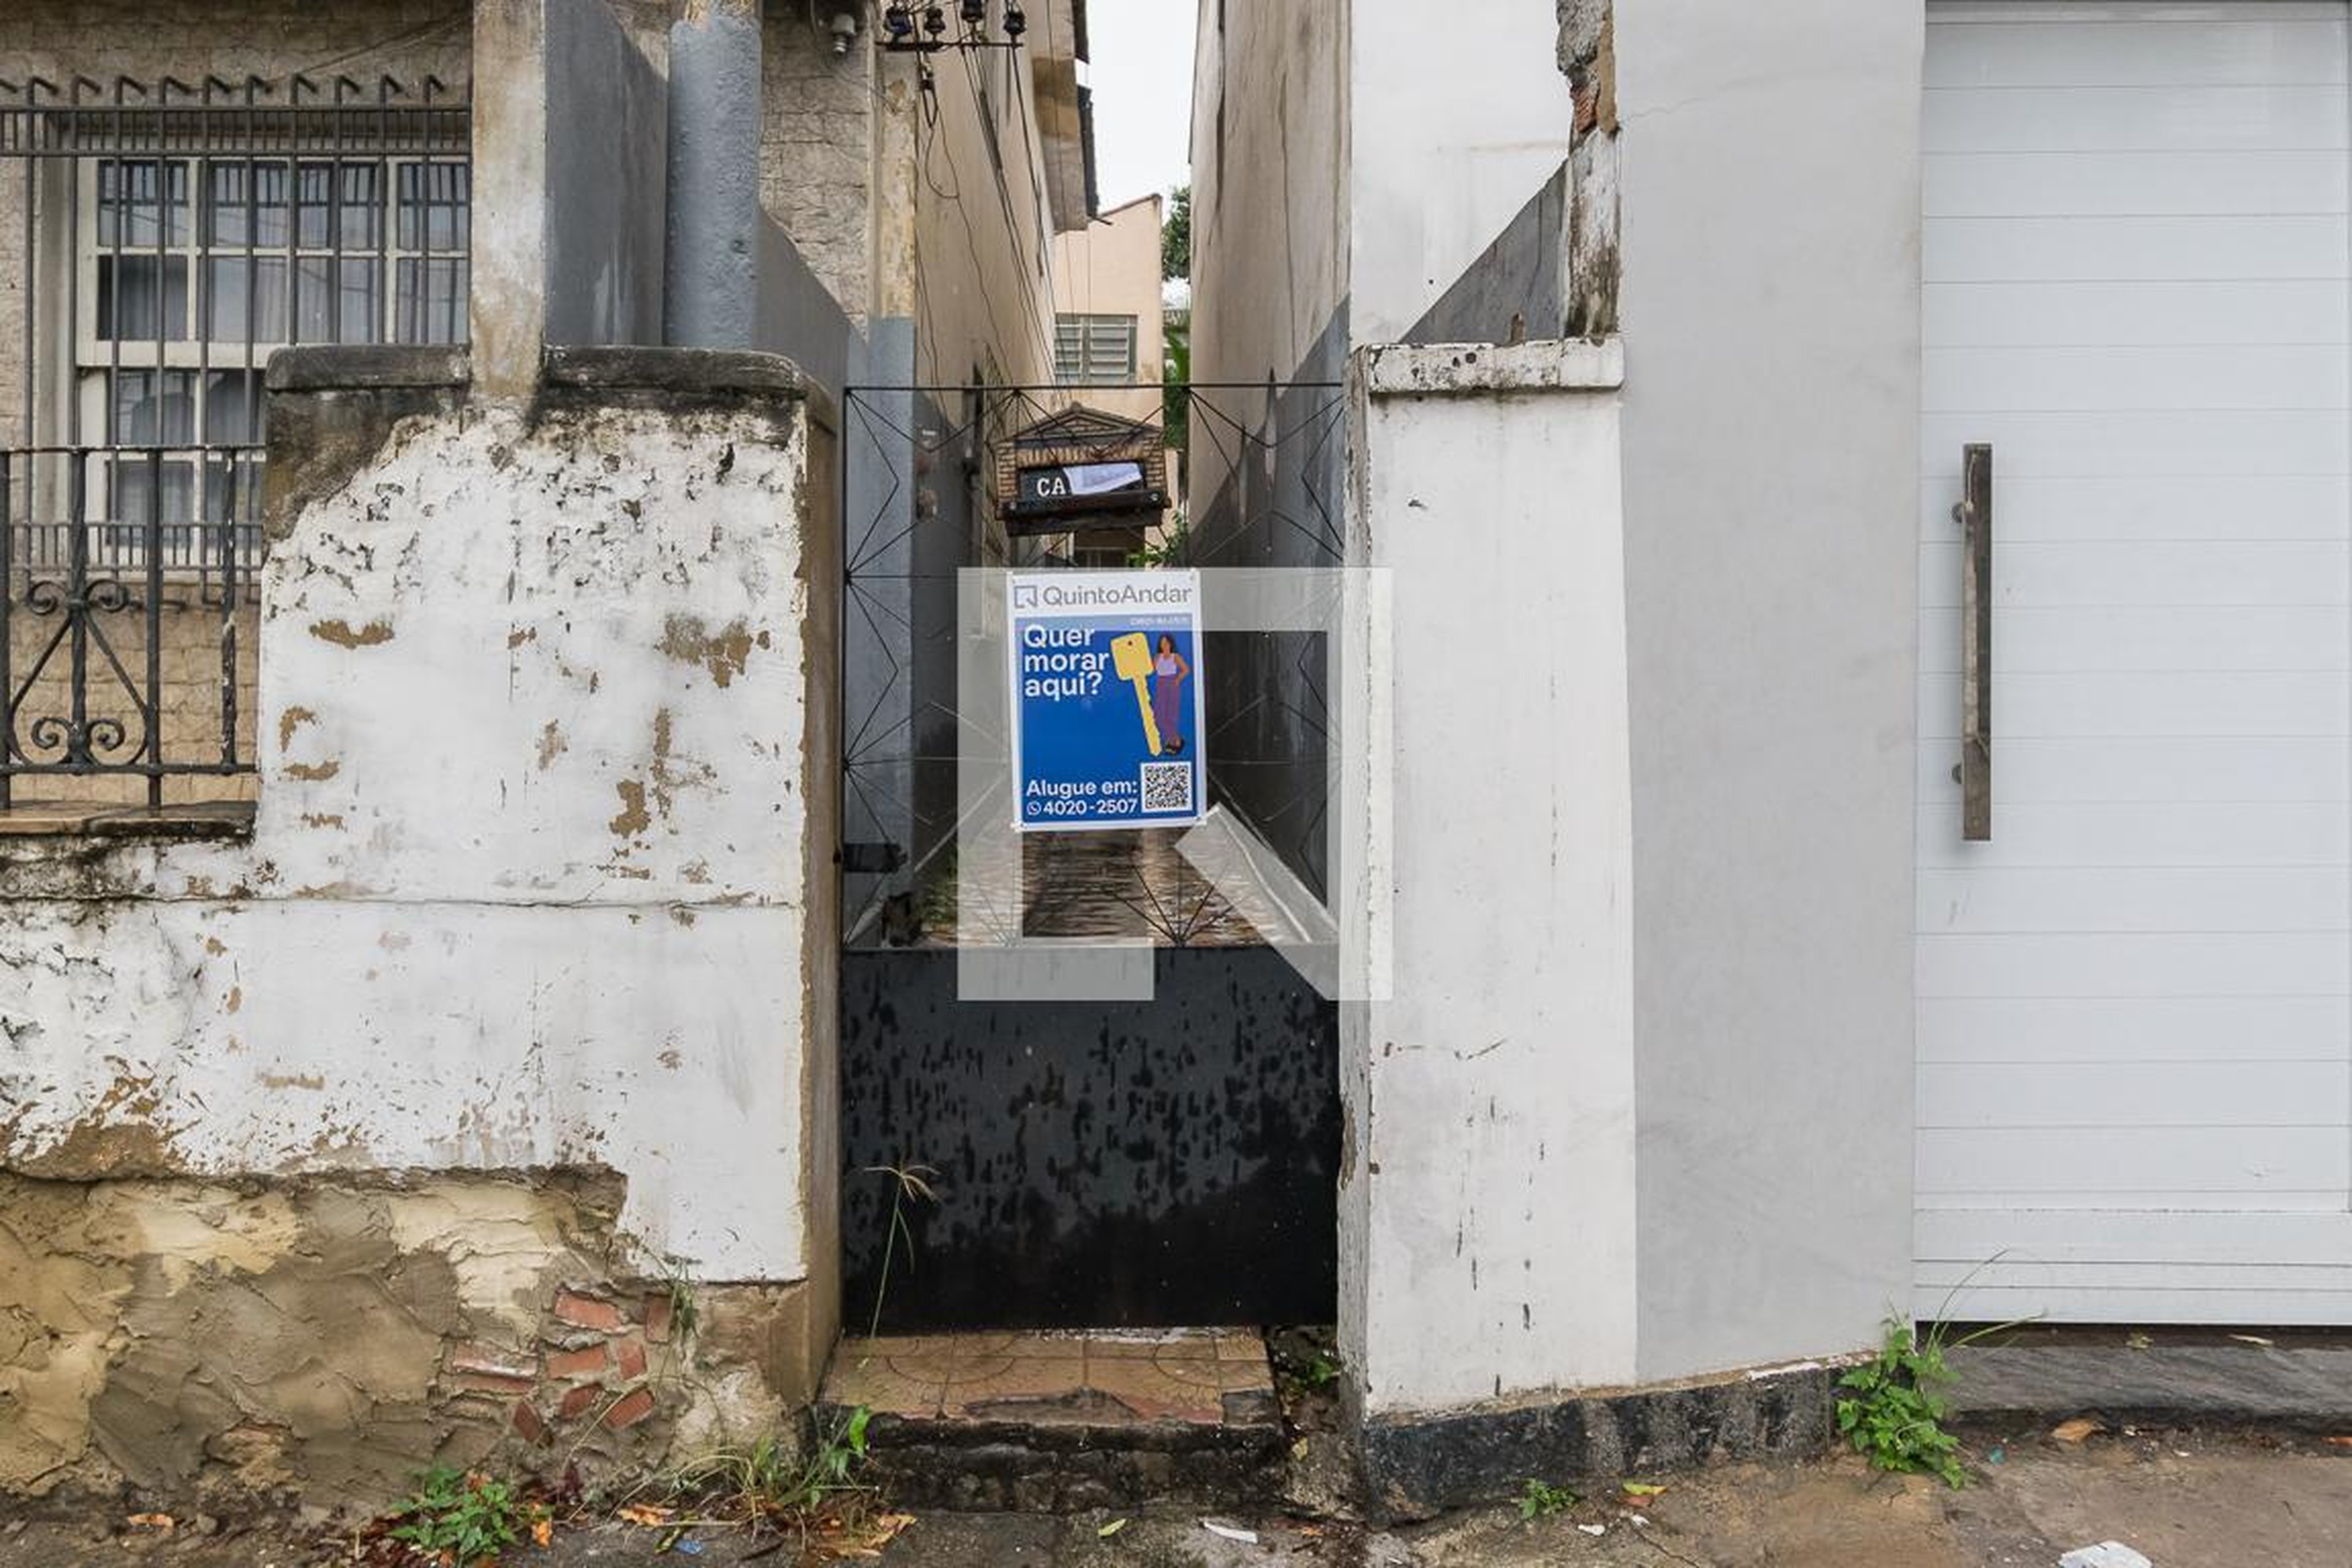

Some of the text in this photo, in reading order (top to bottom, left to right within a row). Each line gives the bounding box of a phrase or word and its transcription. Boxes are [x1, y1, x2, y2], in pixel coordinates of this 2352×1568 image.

[1043, 584, 1192, 606] QuintoAndar
[1024, 624, 1095, 648] Quer
[1024, 652, 1109, 673] morar
[1024, 671, 1102, 701] aqui?
[1026, 780, 1138, 799] Alugue em:
